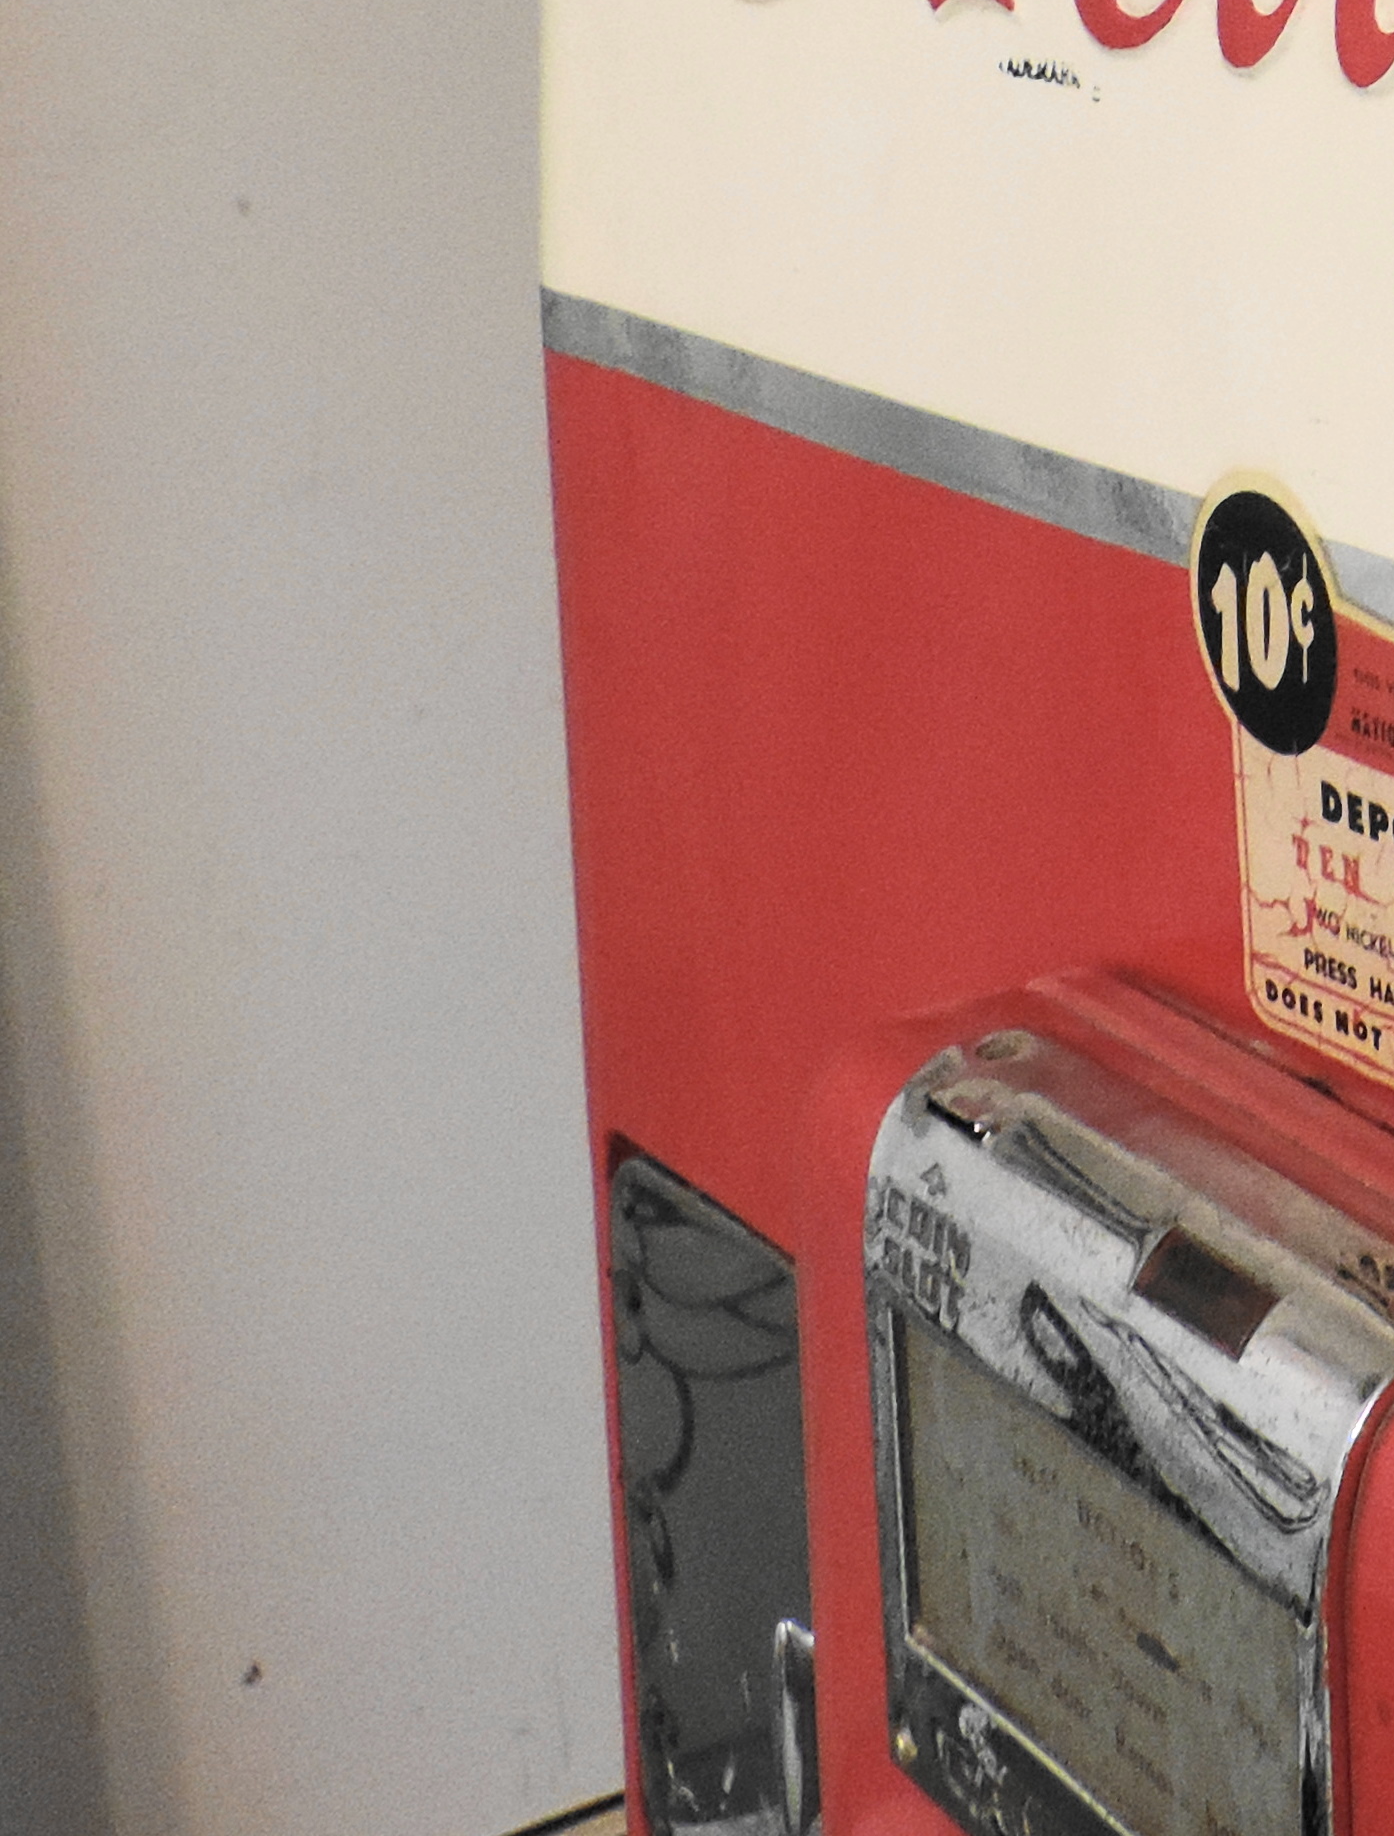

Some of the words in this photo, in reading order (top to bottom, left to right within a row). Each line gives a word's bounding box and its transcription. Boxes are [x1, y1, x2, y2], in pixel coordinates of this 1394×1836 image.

[1292, 833, 1360, 893] TEN
[1303, 947, 1357, 990] PRESS
[1265, 978, 1323, 1024] DOES
[1335, 1009, 1382, 1051] NOT
